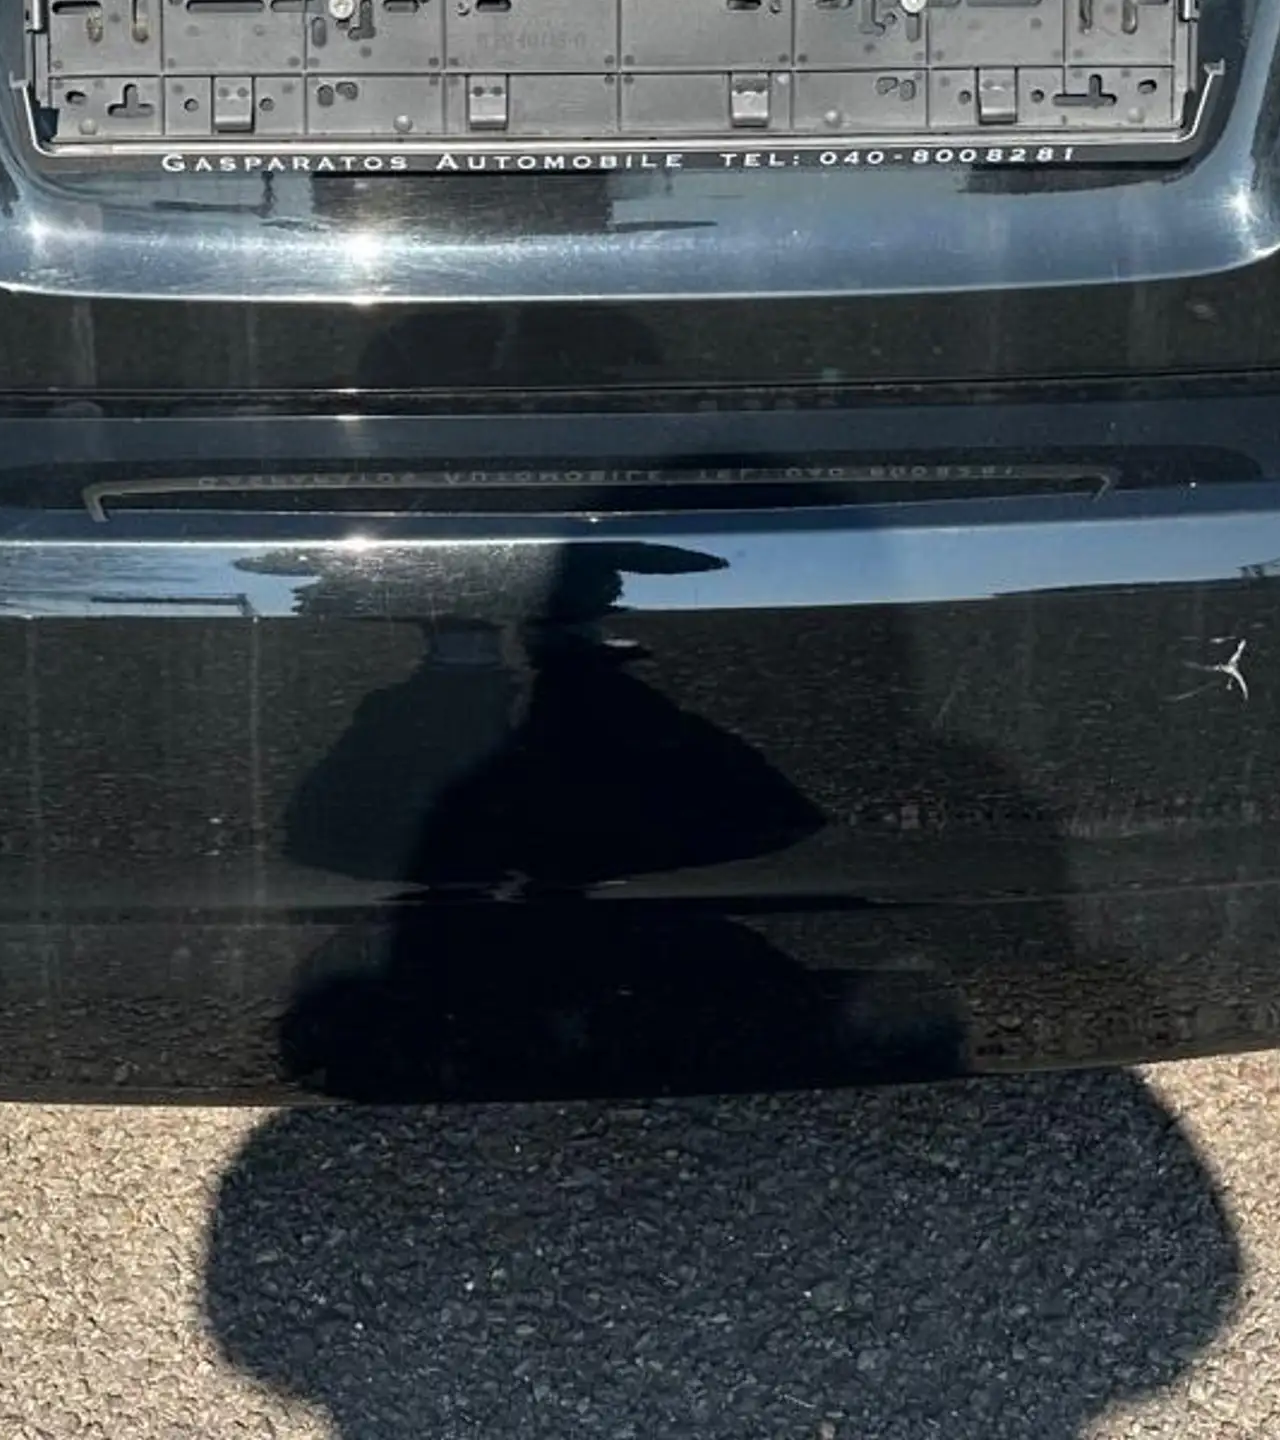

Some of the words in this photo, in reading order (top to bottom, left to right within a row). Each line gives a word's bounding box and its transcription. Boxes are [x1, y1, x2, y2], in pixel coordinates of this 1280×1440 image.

[162, 152, 408, 172] GASPARATOS
[436, 152, 683, 171] AUTOMOBILE
[720, 152, 800, 169] TEL:
[819, 146, 1075, 166] 040-8008281
